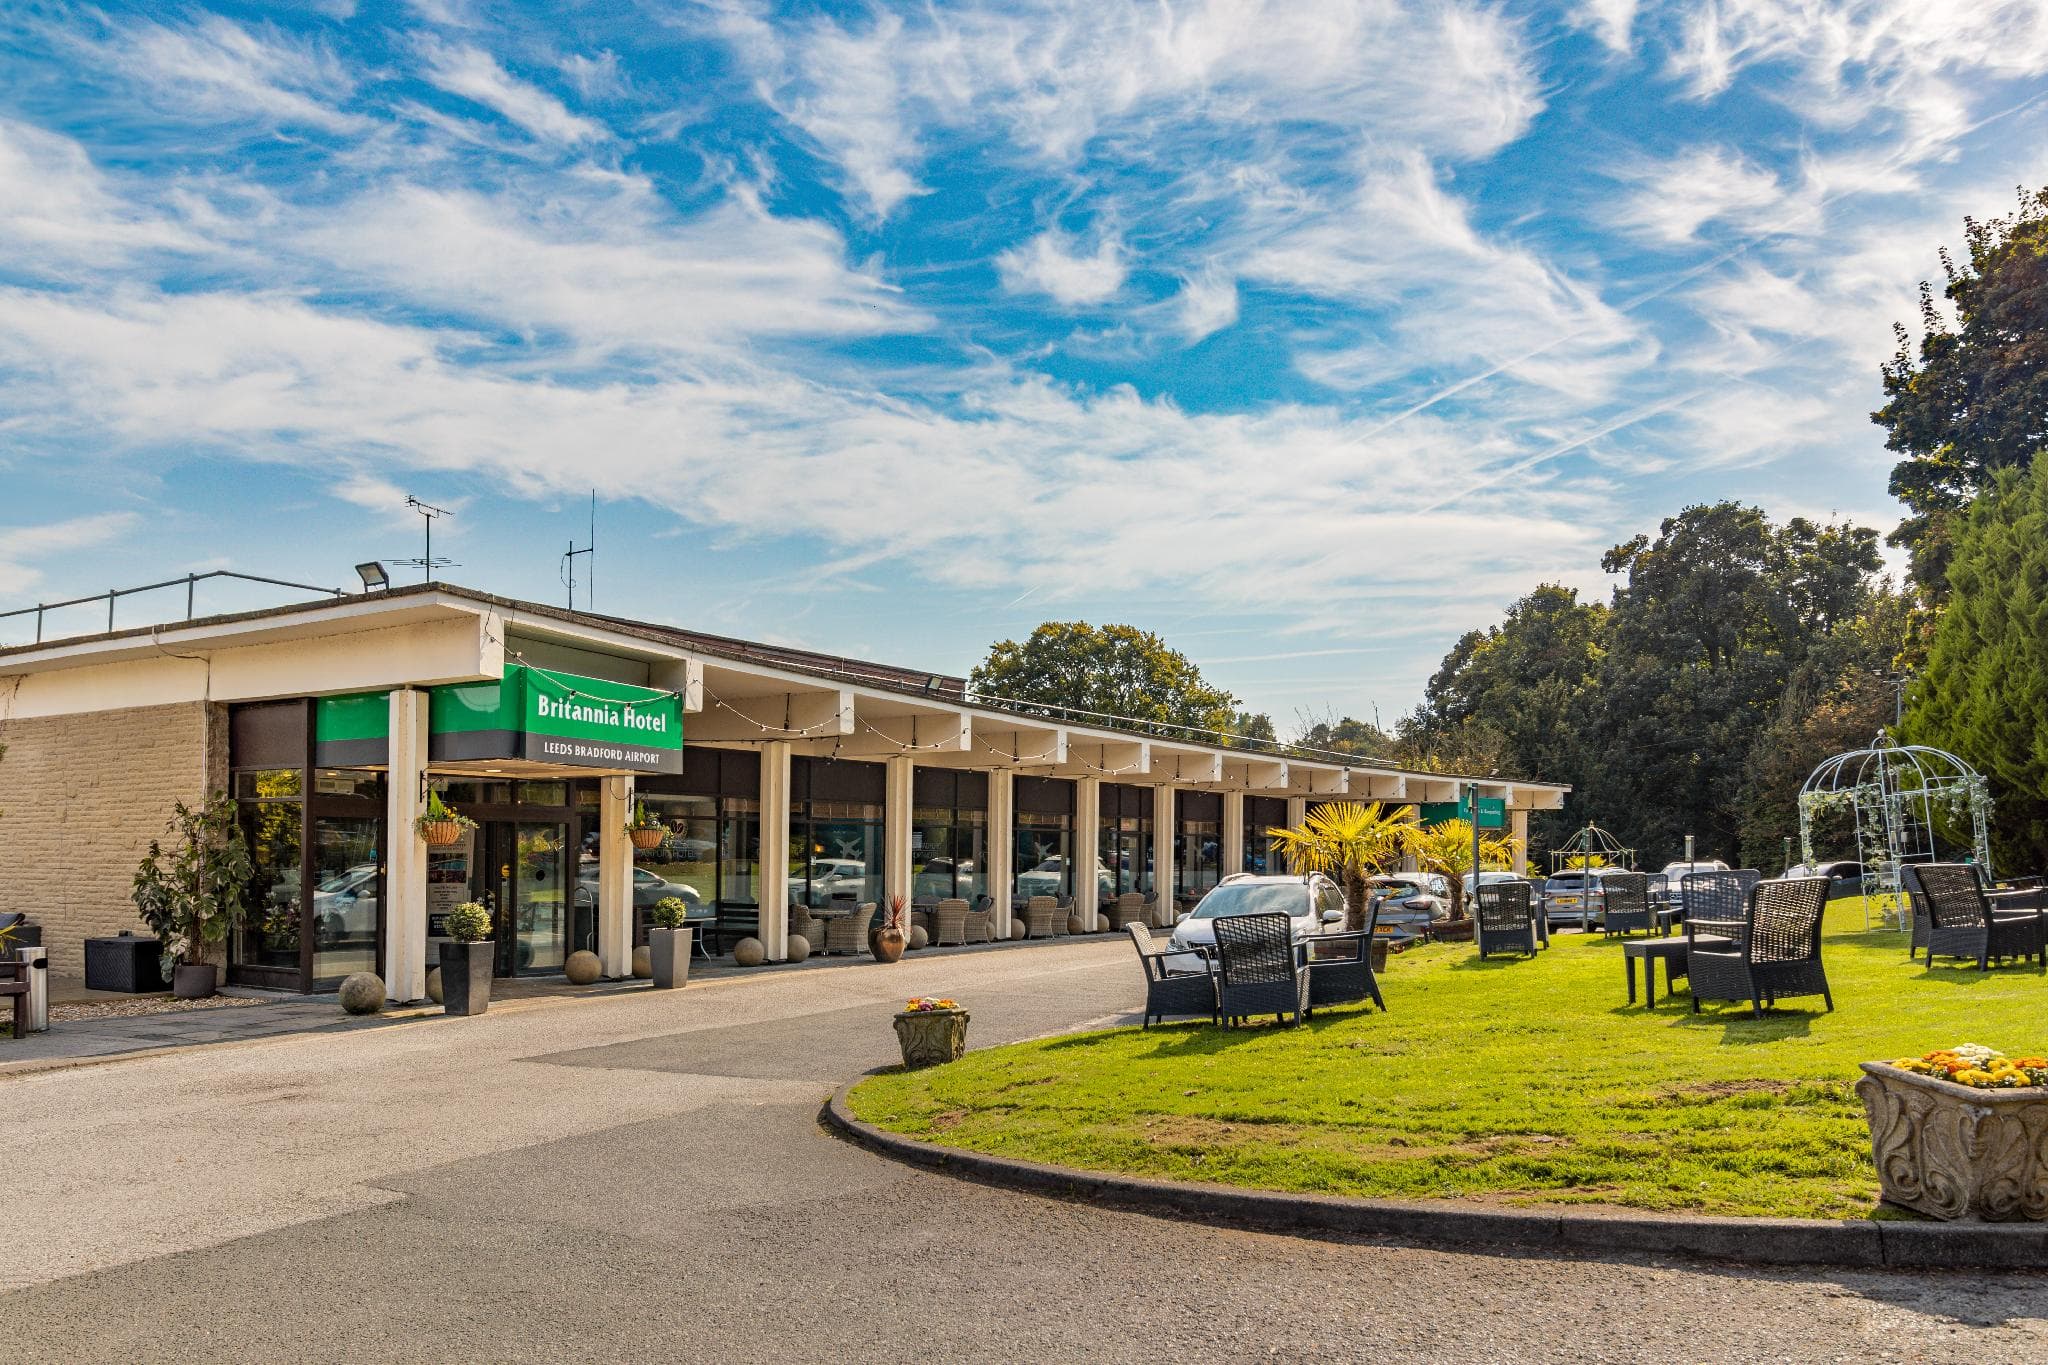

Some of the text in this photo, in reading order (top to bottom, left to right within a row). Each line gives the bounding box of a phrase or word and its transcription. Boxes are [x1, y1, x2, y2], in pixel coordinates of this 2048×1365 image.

[538, 694, 667, 733] Britannia Hotel
[544, 741, 661, 764] LEEDS BRADFORD AIRPORT
